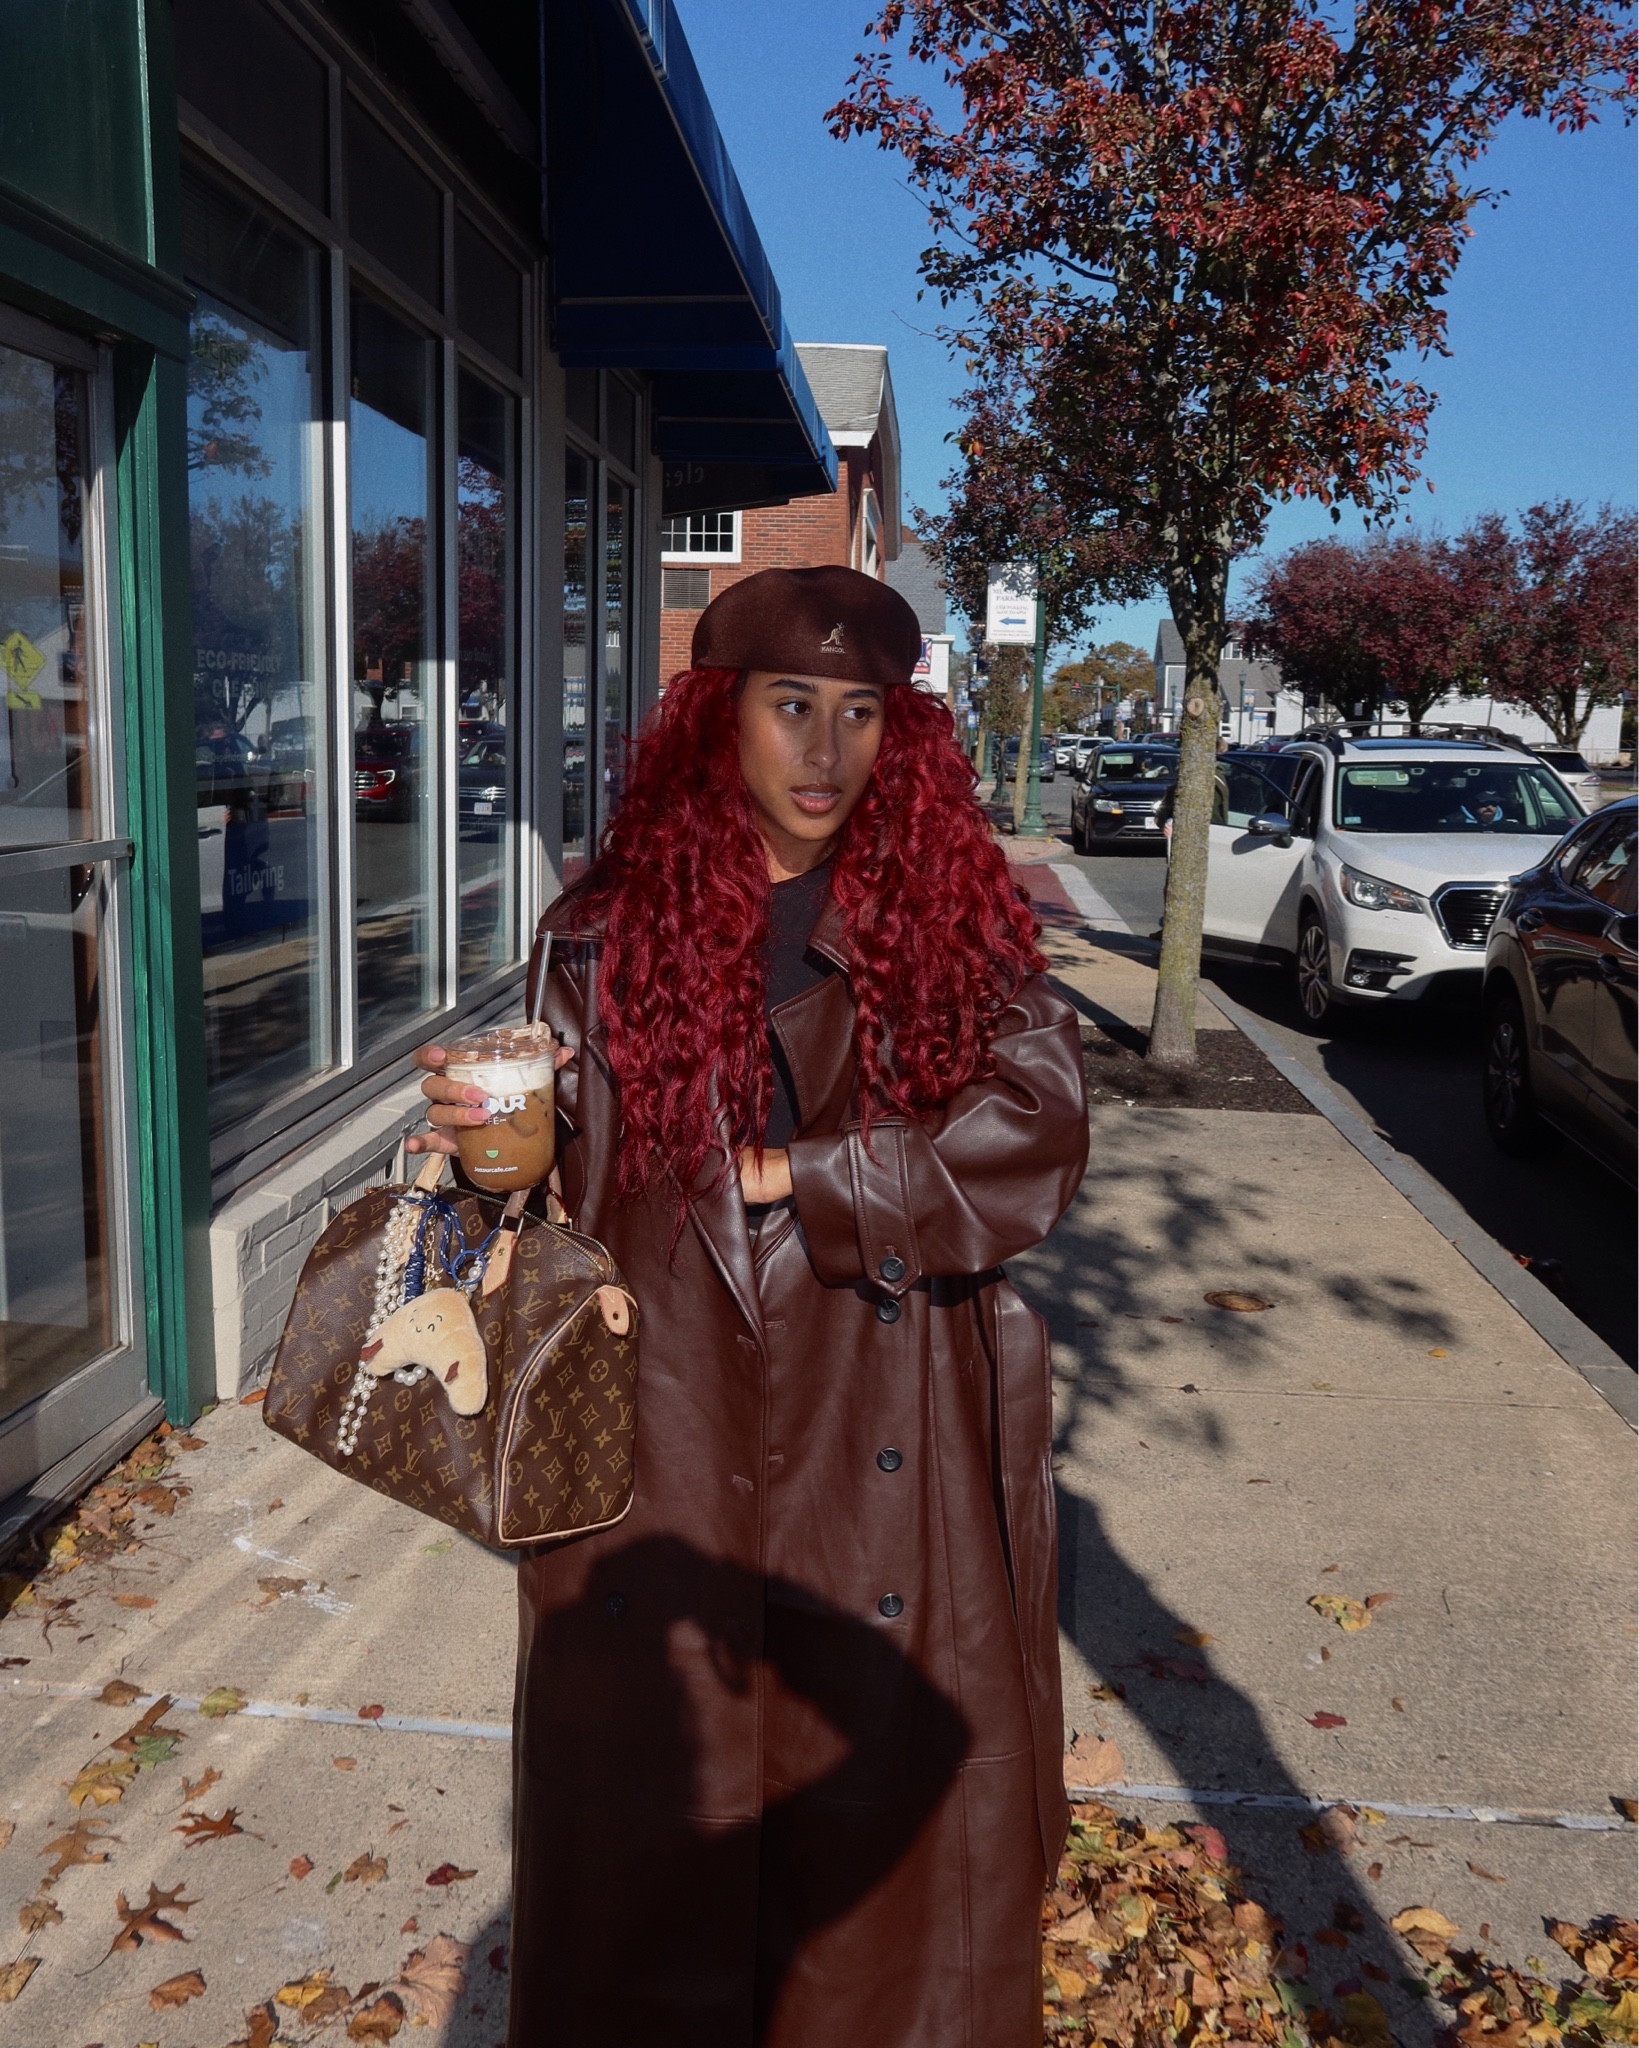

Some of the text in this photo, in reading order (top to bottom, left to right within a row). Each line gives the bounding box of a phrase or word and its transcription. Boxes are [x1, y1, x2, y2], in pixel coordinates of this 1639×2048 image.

[821, 646, 846, 654] KANGOL
[212, 678, 273, 698] CLEING
[228, 861, 284, 896] Tailoring
